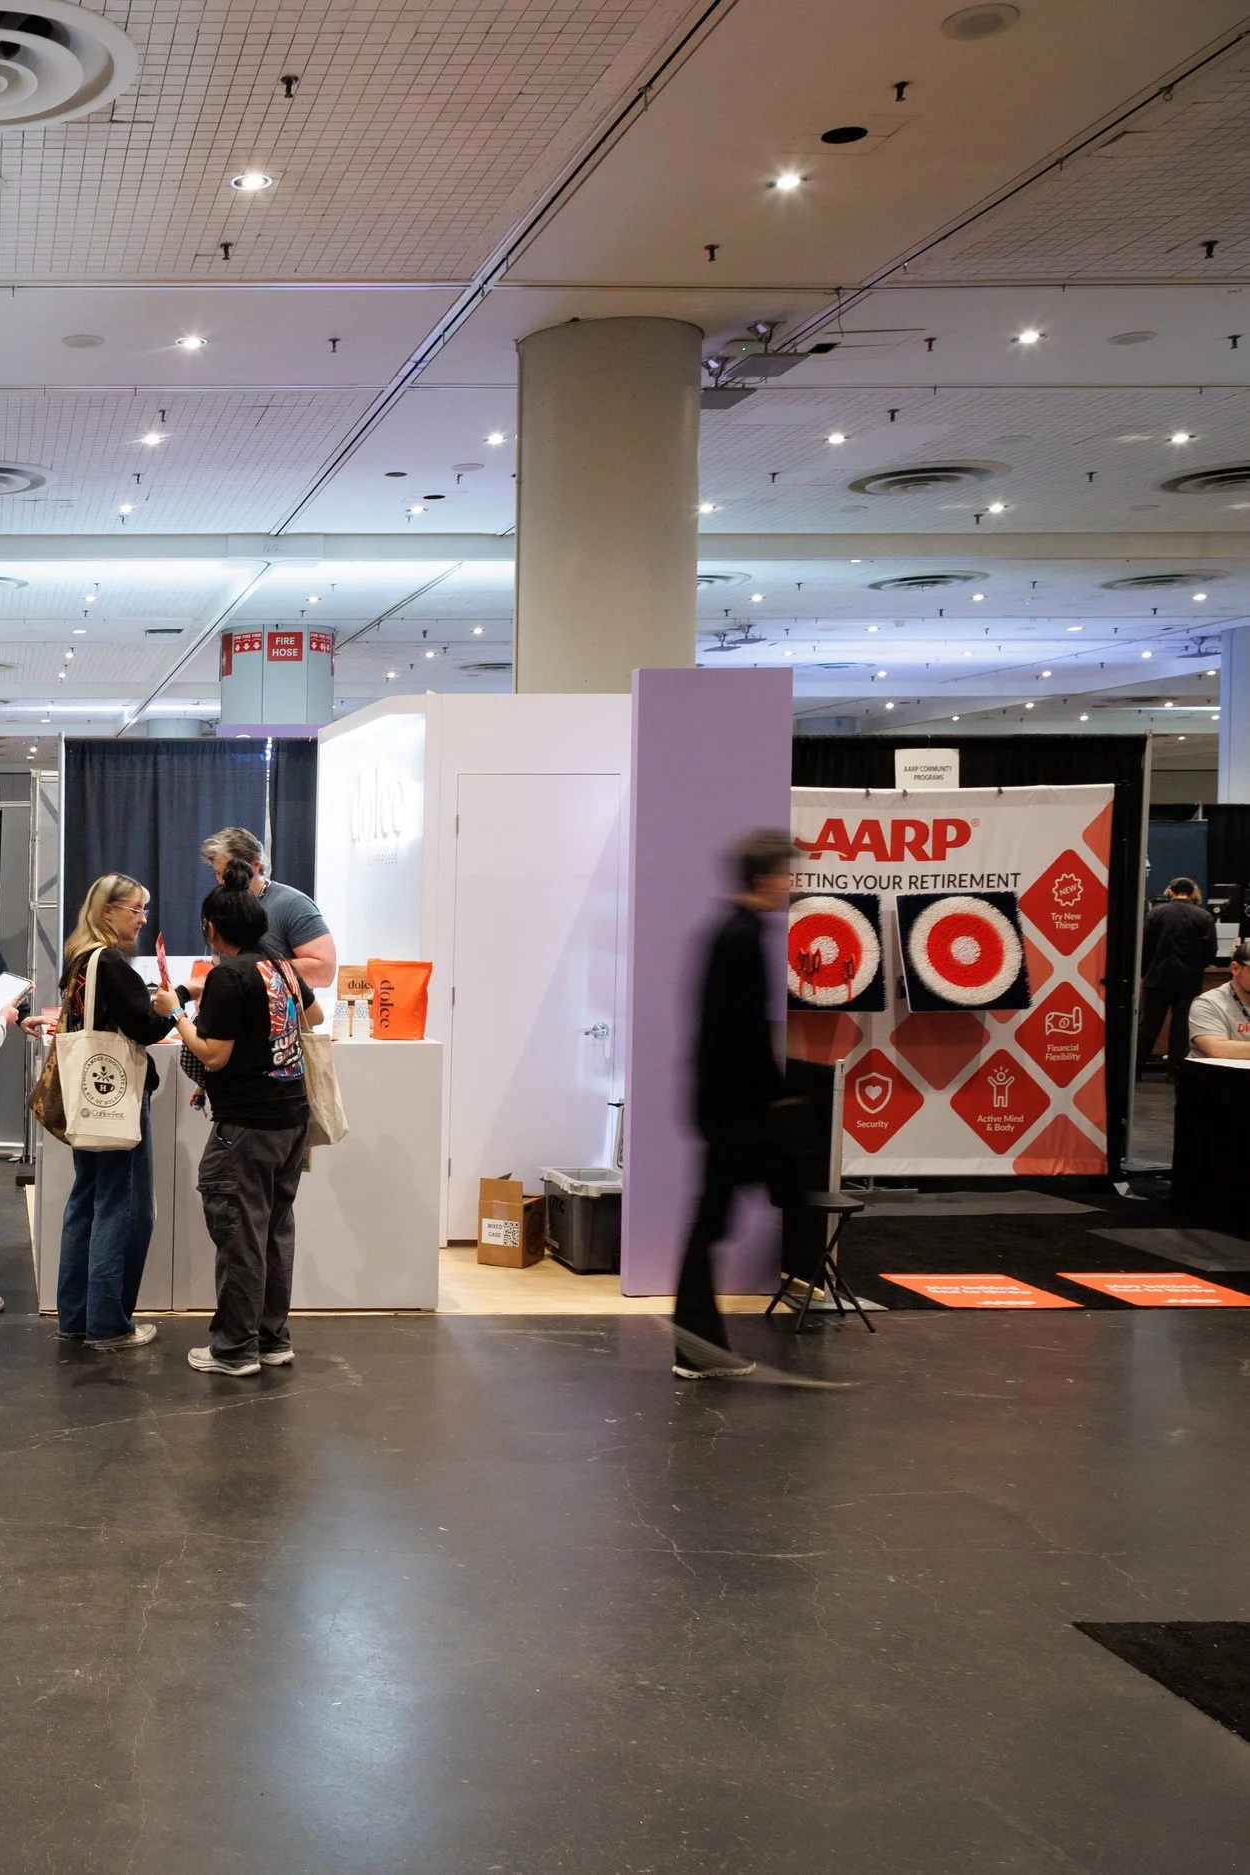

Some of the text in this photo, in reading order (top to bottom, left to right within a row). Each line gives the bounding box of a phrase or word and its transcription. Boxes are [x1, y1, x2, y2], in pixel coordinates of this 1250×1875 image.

[275, 637, 295, 645] FIRE
[272, 648, 298, 657] HOSE
[852, 874, 903, 890] YOUR
[909, 872, 1021, 890] RETIREMENT
[1059, 884, 1077, 896] NEW
[1051, 913, 1063, 922] Try
[1054, 921, 1079, 931] Things
[379, 980, 395, 1028] dolce
[1047, 1044, 1079, 1052] Financial
[1045, 1053, 1081, 1062] Flexibility
[977, 1114, 1024, 1123] Active Mind
[856, 1120, 888, 1129] Security
[994, 1124, 1015, 1133] Body
